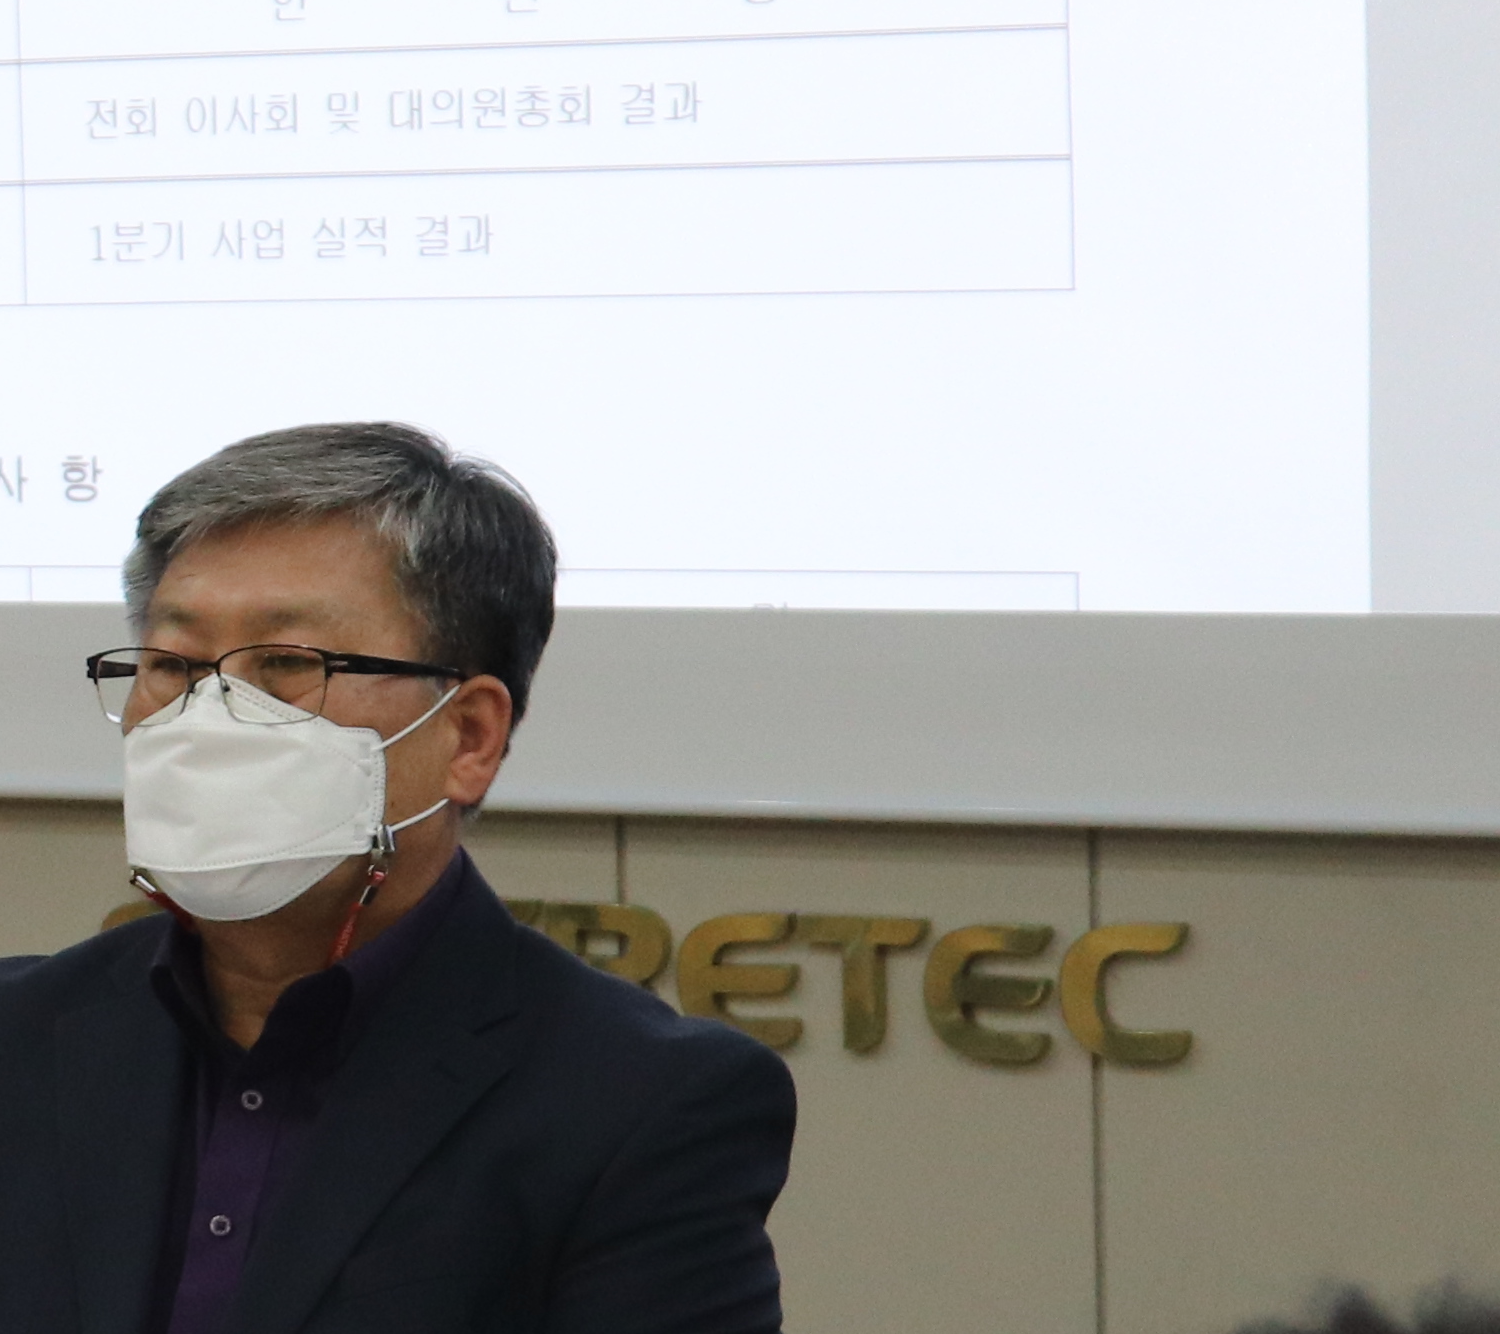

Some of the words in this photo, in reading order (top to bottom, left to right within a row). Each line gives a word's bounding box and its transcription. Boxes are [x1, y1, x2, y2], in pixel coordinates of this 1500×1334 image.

[84, 94, 159, 144] 전회
[182, 86, 301, 137] 이사회
[323, 88, 363, 134] 및
[386, 80, 594, 131] 대의원총회
[618, 75, 703, 127] 결과
[88, 217, 189, 266] 1분기
[210, 215, 288, 265] 사업
[311, 211, 390, 260] 실적
[413, 210, 496, 259] 결과
[504, 897, 1193, 1067] RETEC
